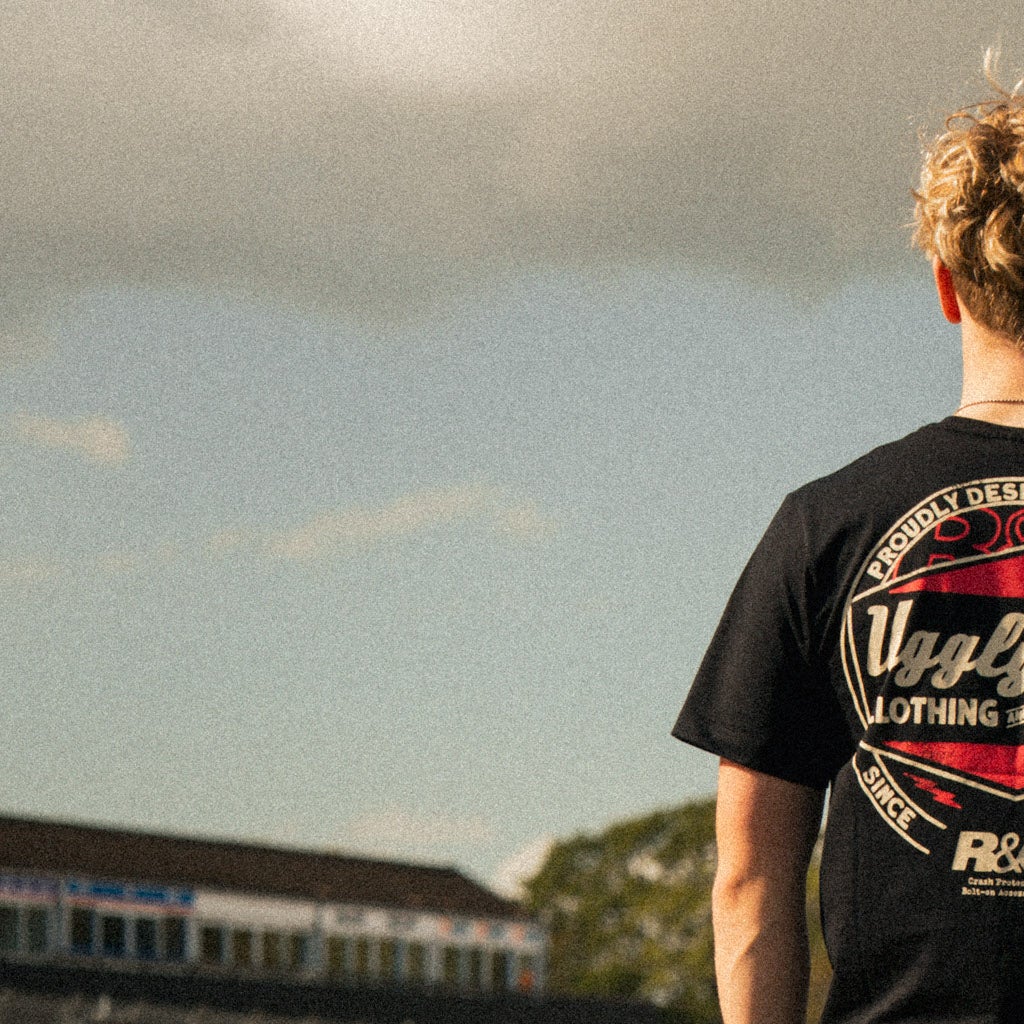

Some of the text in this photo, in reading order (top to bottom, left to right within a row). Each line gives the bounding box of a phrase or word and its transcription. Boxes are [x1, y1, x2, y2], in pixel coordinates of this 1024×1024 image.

[866, 491, 959, 580] PROUDLY
[868, 695, 999, 727] LOTHING
[862, 765, 918, 831] SINCE
[967, 876, 994, 886] Crash
